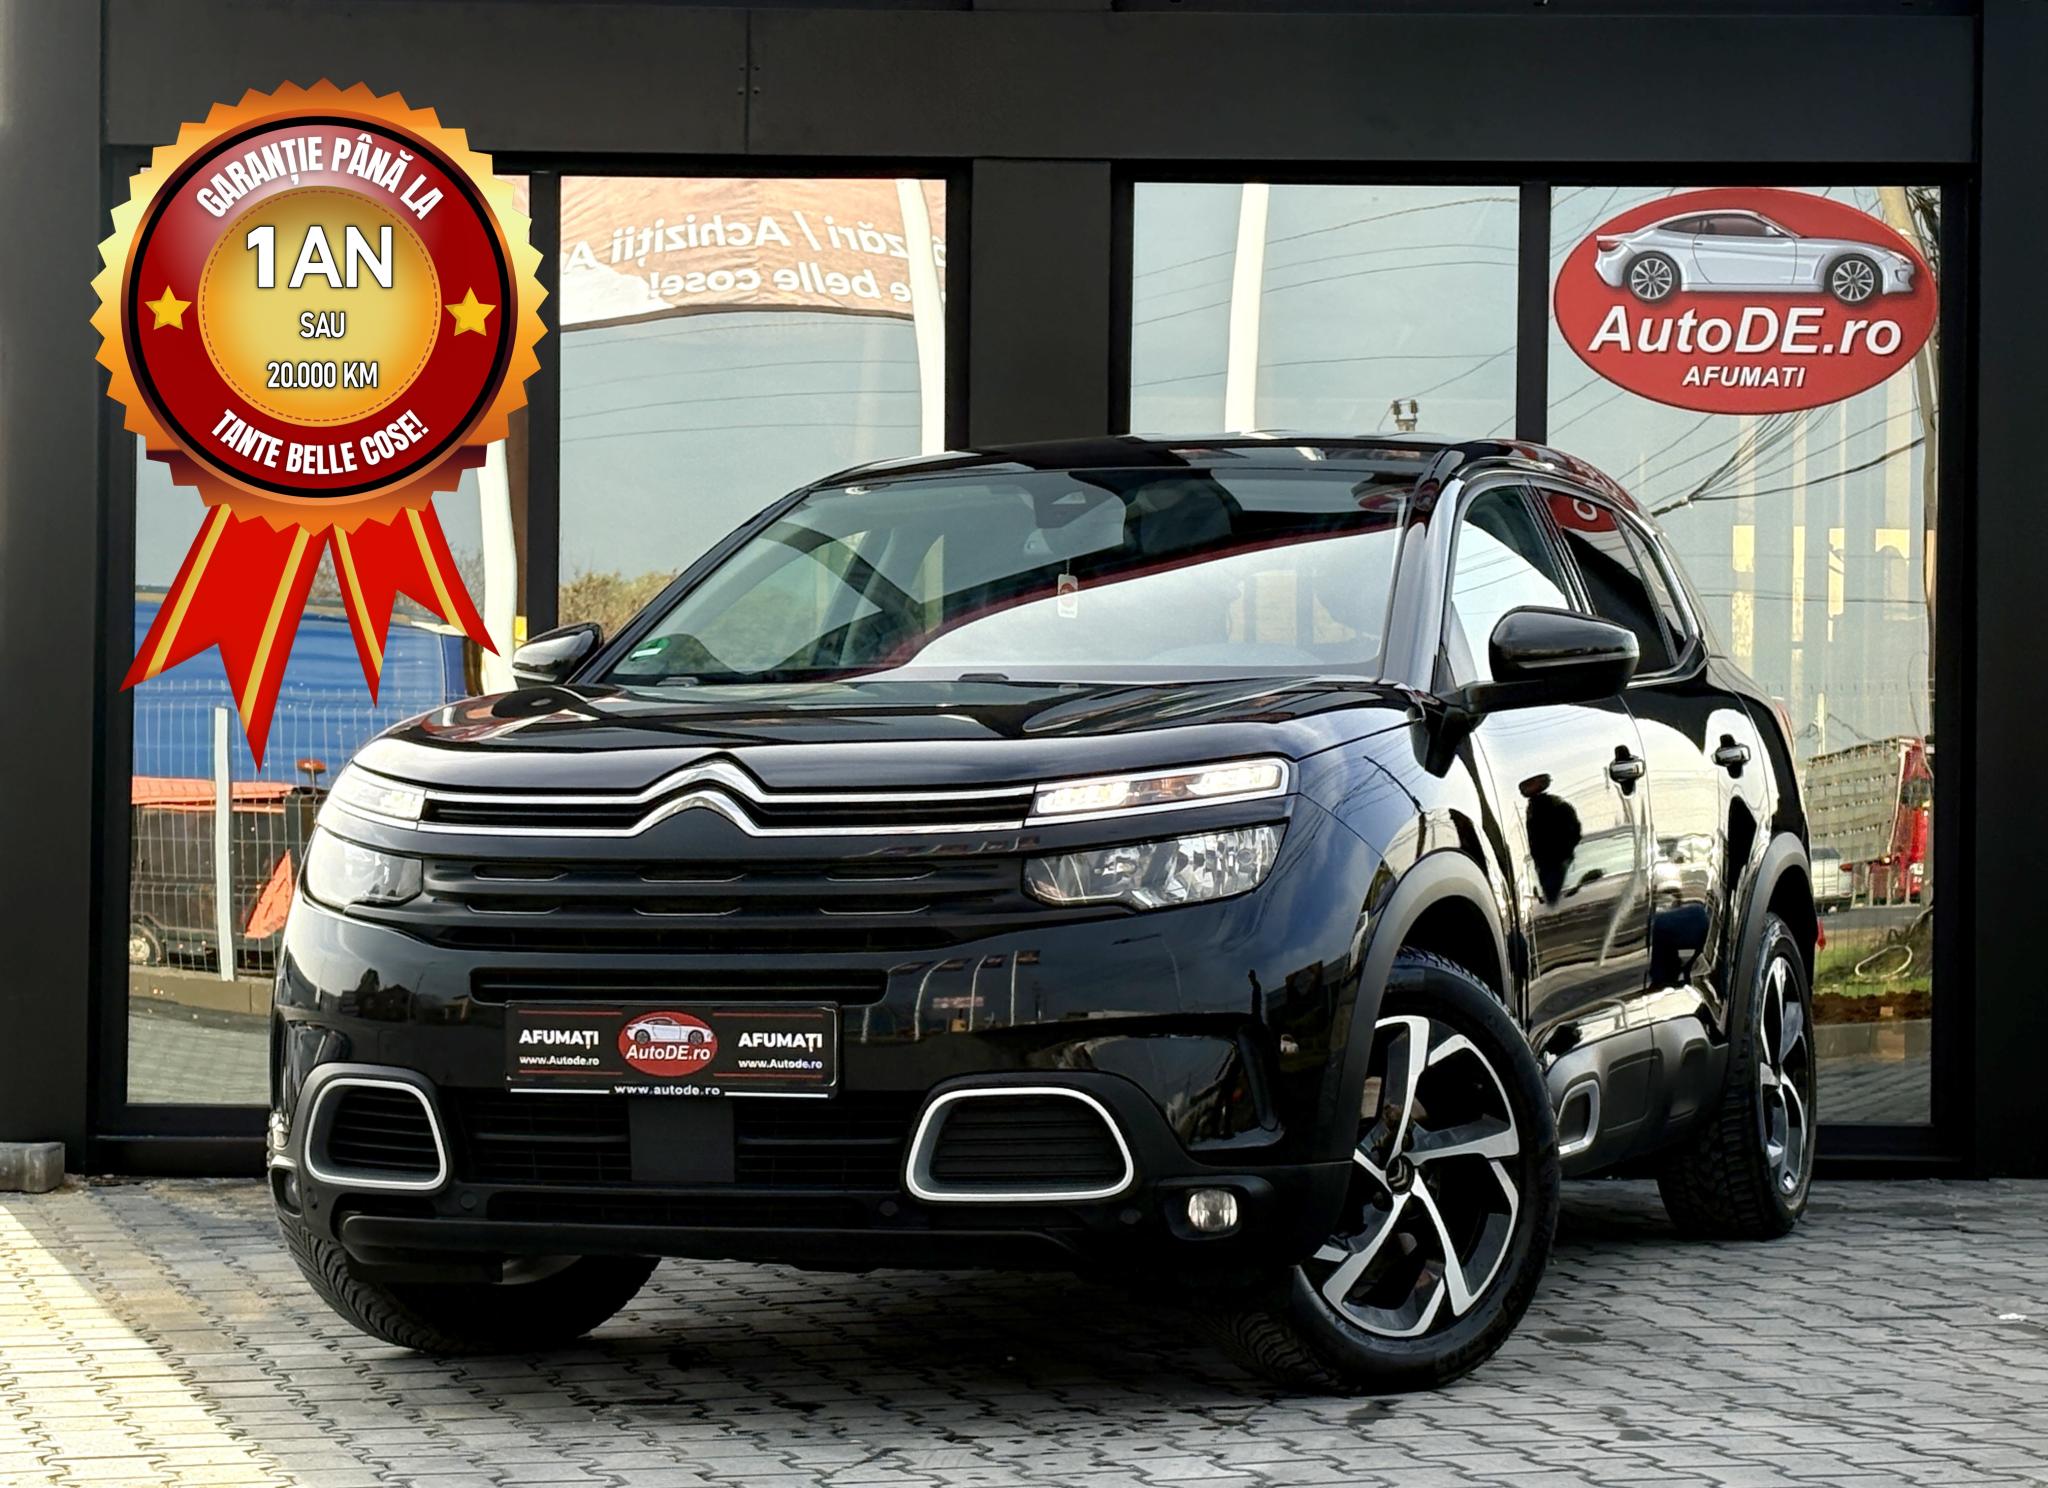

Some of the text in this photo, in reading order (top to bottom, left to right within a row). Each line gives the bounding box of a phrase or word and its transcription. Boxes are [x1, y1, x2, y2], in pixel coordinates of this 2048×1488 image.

[1588, 304, 1903, 356] AutoDE.ro
[1682, 366, 1806, 388] AFUMATI
[519, 1055, 600, 1066] www.Autode.ro
[625, 1044, 711, 1062] AutoDE.ro
[738, 1058, 823, 1069] www.Autode.ro
[613, 1083, 720, 1096] www.autode.ro
